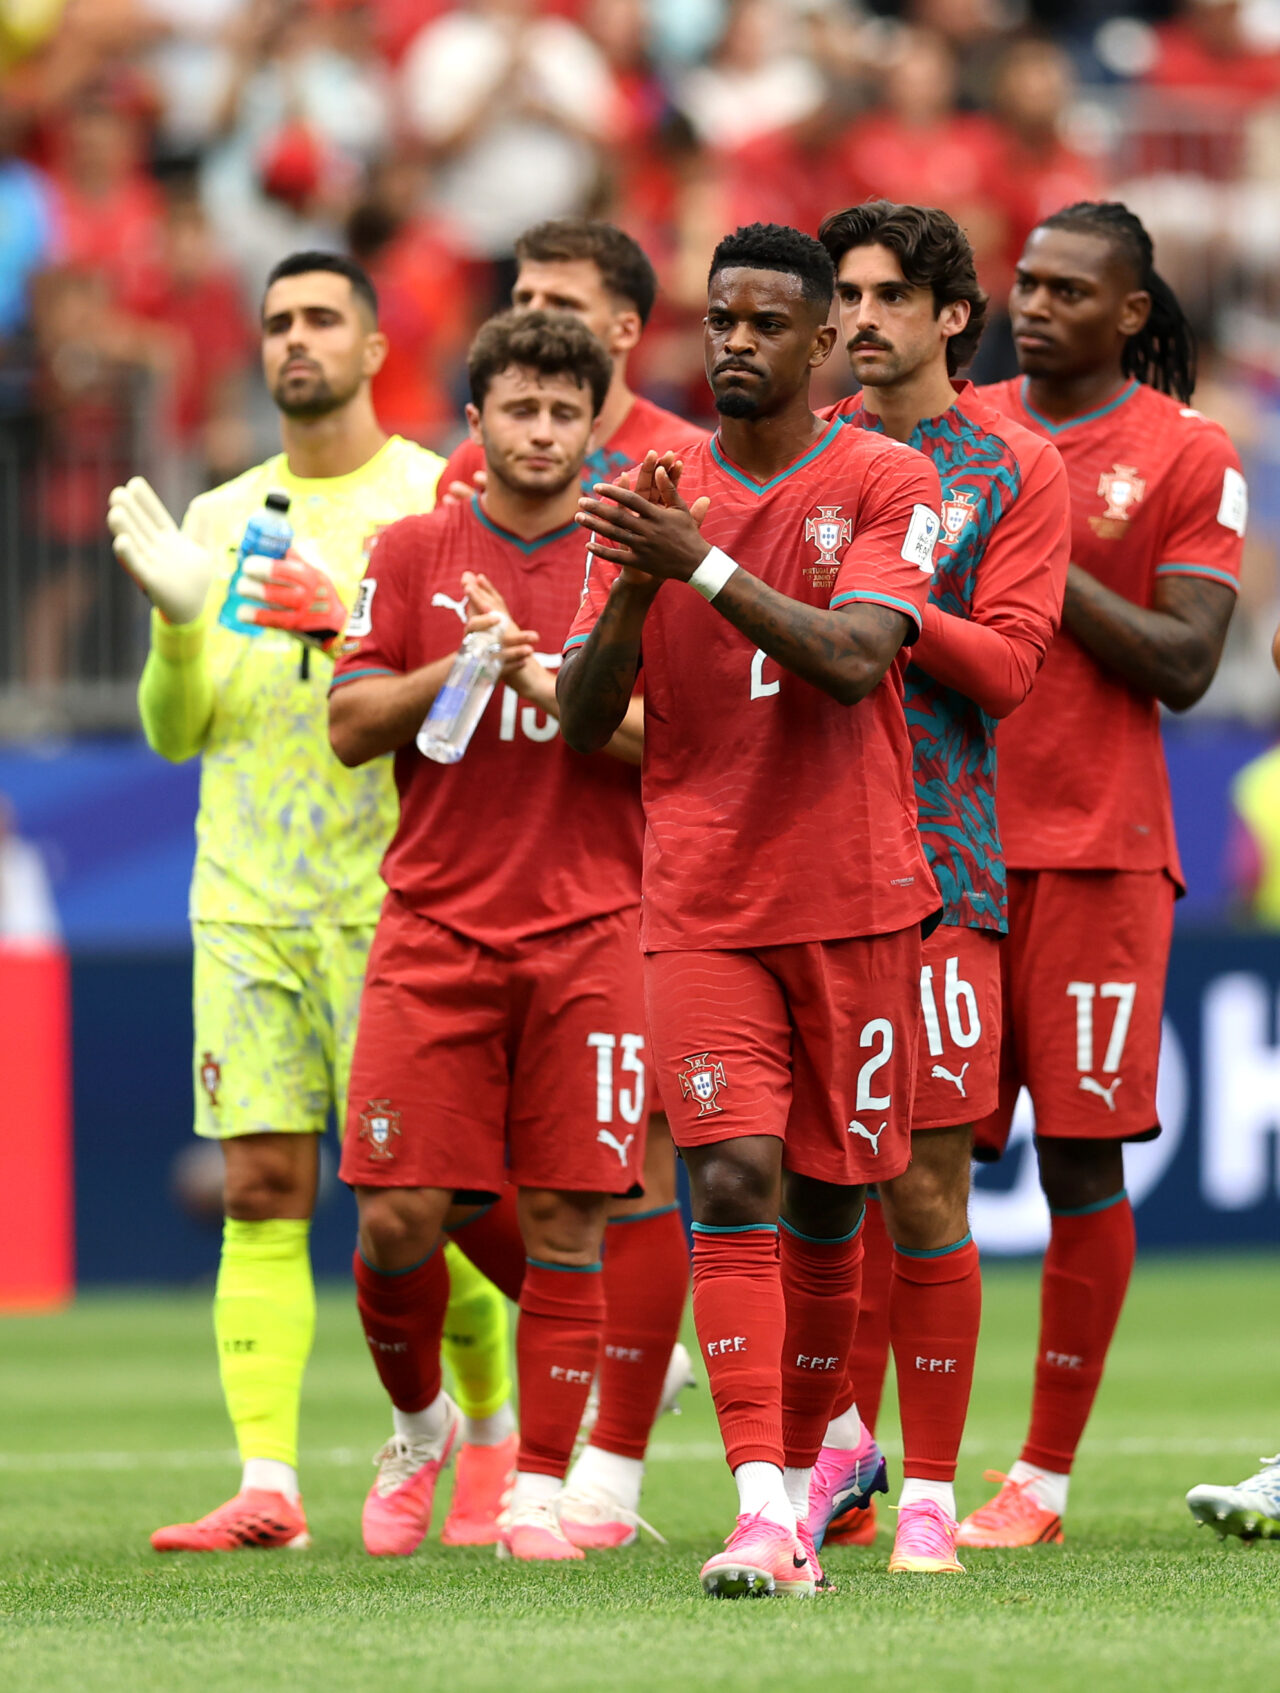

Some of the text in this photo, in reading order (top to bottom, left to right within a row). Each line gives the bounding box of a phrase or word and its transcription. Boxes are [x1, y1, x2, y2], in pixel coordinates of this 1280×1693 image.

[919, 957, 981, 1056] 16
[1066, 981, 1137, 1073] 17
[587, 1032, 645, 1124] 15
[856, 1017, 894, 1112] 2
[707, 1336, 747, 1357] F.P.F.
[797, 1353, 839, 1370] F.P.F.
[915, 1356, 957, 1374] F.P.F.
